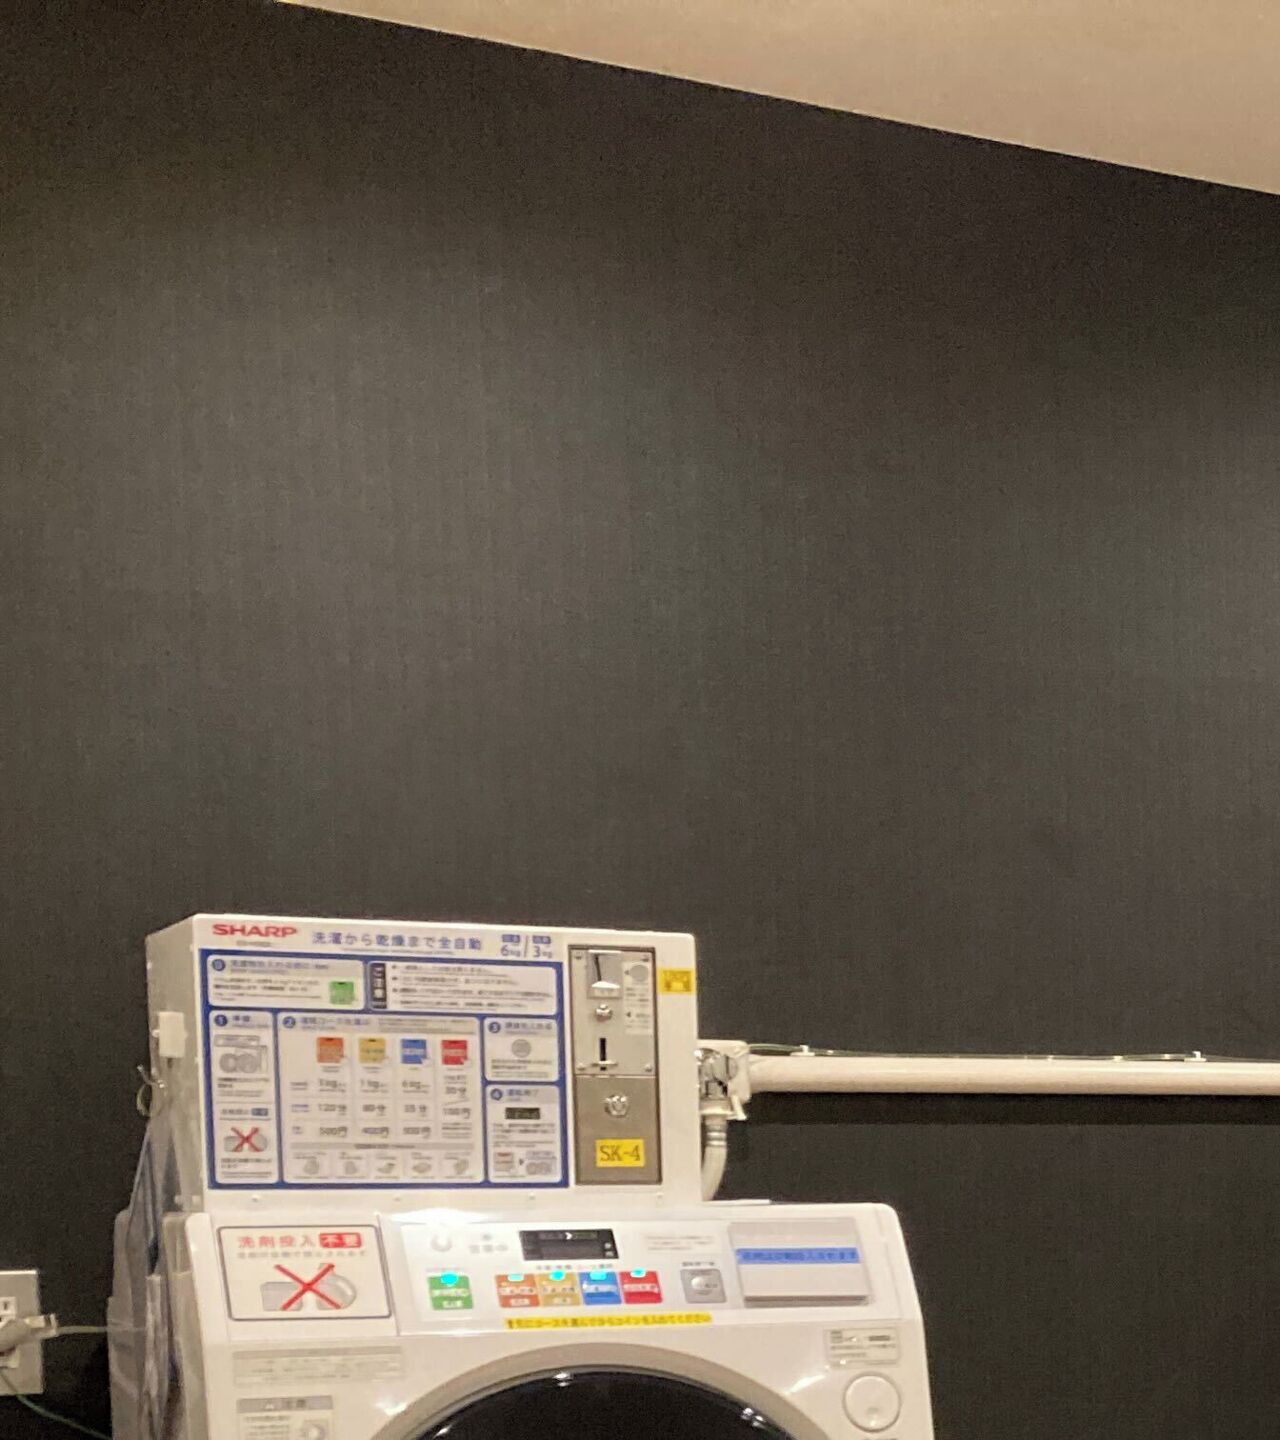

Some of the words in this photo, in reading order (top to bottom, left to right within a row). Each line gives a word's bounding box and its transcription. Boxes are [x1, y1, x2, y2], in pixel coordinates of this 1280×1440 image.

[212, 923, 297, 939] SHARP
[312, 931, 482, 951] 洗濯から乾燥まで全自動
[599, 1144, 642, 1162] SK-4
[237, 1234, 316, 1248] 洗剤投入
